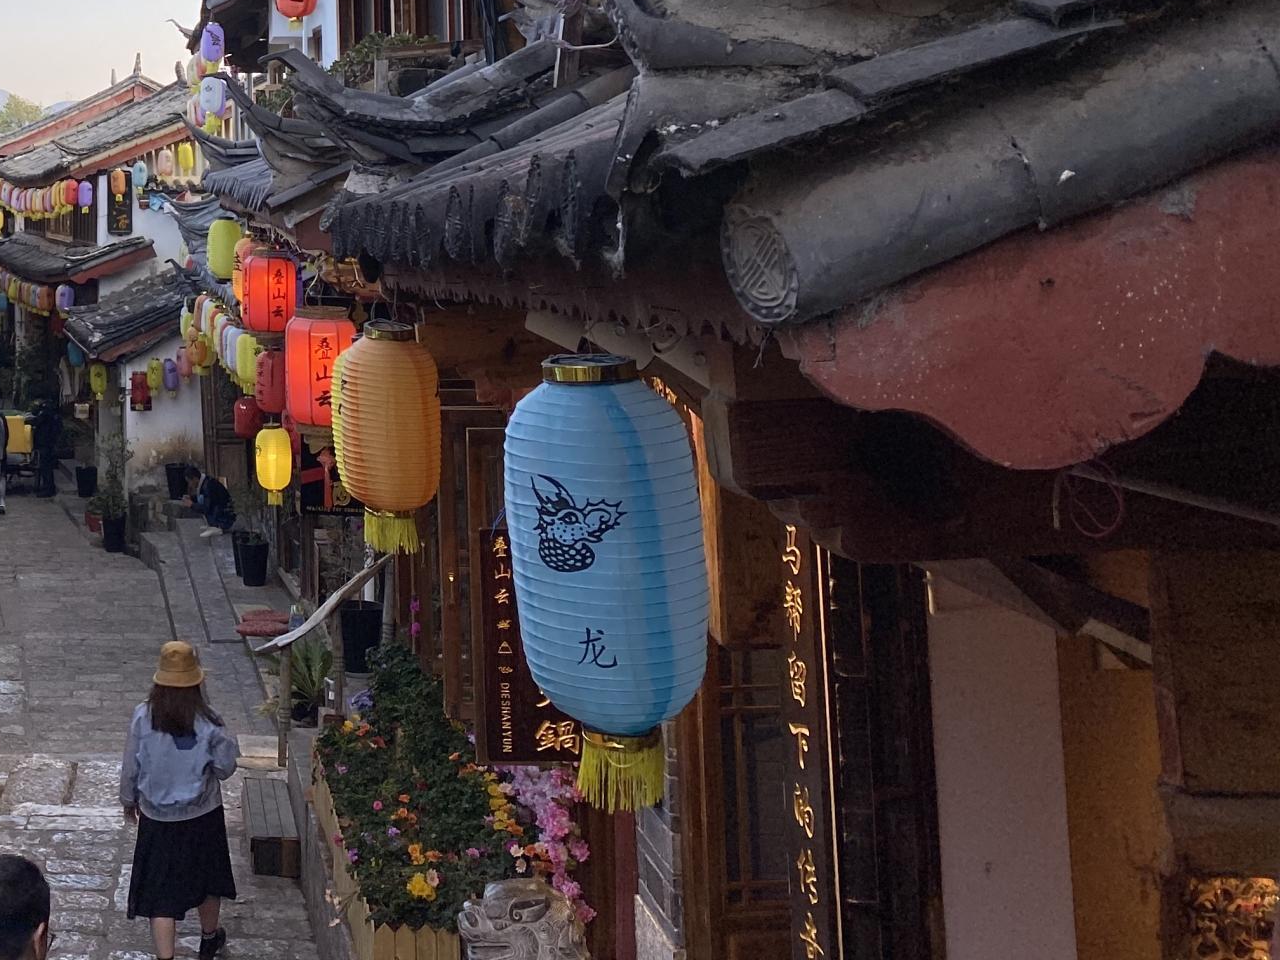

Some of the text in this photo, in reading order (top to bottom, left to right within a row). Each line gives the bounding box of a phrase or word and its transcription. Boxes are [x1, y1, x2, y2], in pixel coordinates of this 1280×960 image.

[272, 268, 286, 318] 叠山云
[492, 535, 512, 606] 叠山云
[577, 626, 619, 669] 龙
[499, 683, 513, 754] DIESHANYUN
